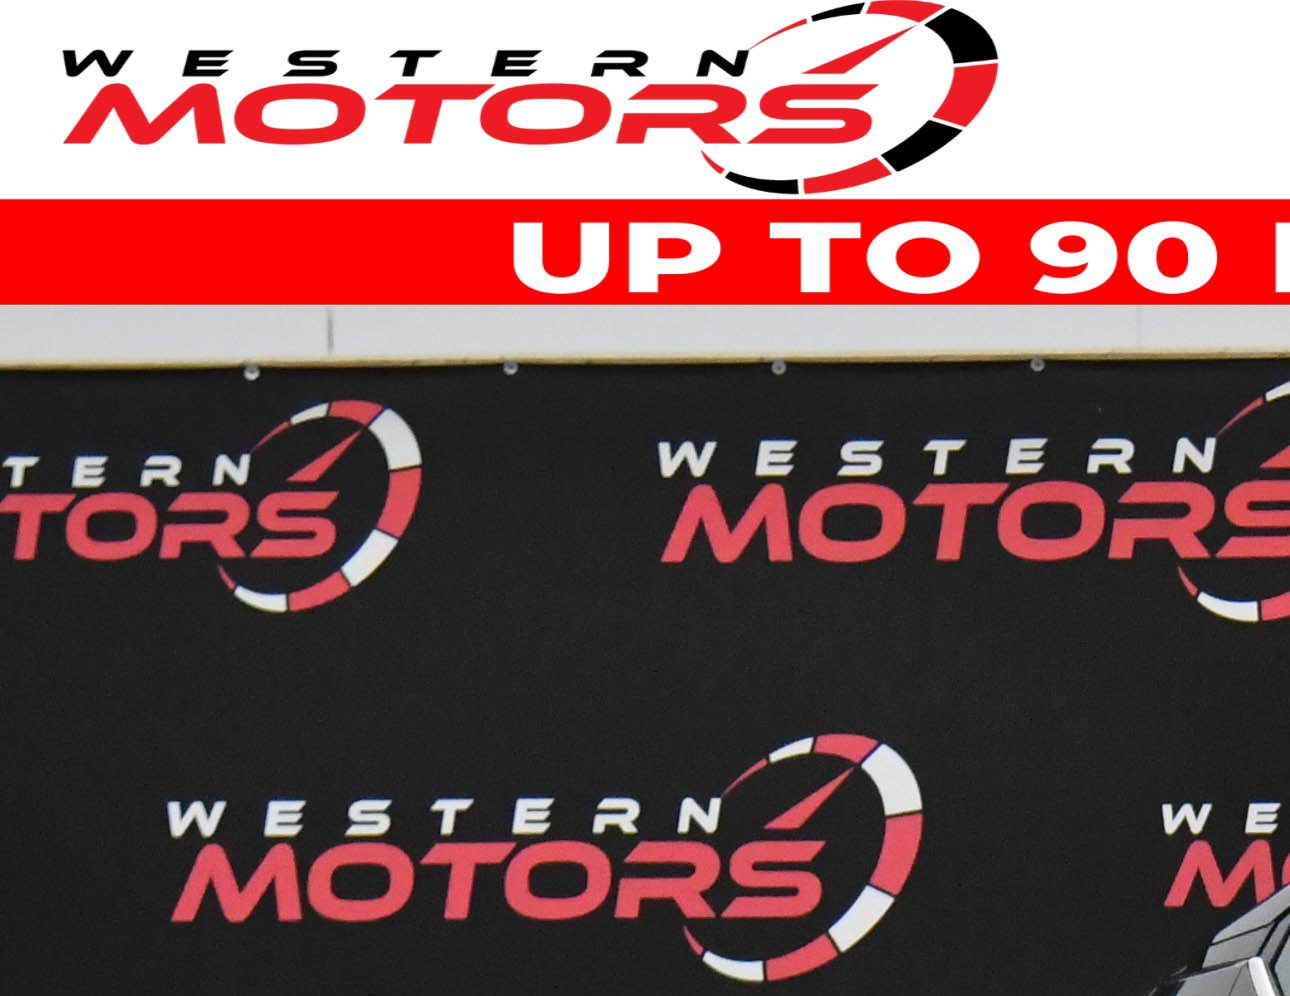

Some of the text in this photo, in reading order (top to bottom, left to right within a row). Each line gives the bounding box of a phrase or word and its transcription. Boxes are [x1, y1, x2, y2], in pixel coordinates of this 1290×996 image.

[658, 437, 1217, 478] WESTERN
[167, 797, 722, 838] WESTERN
[172, 840, 826, 923] MOTORS
